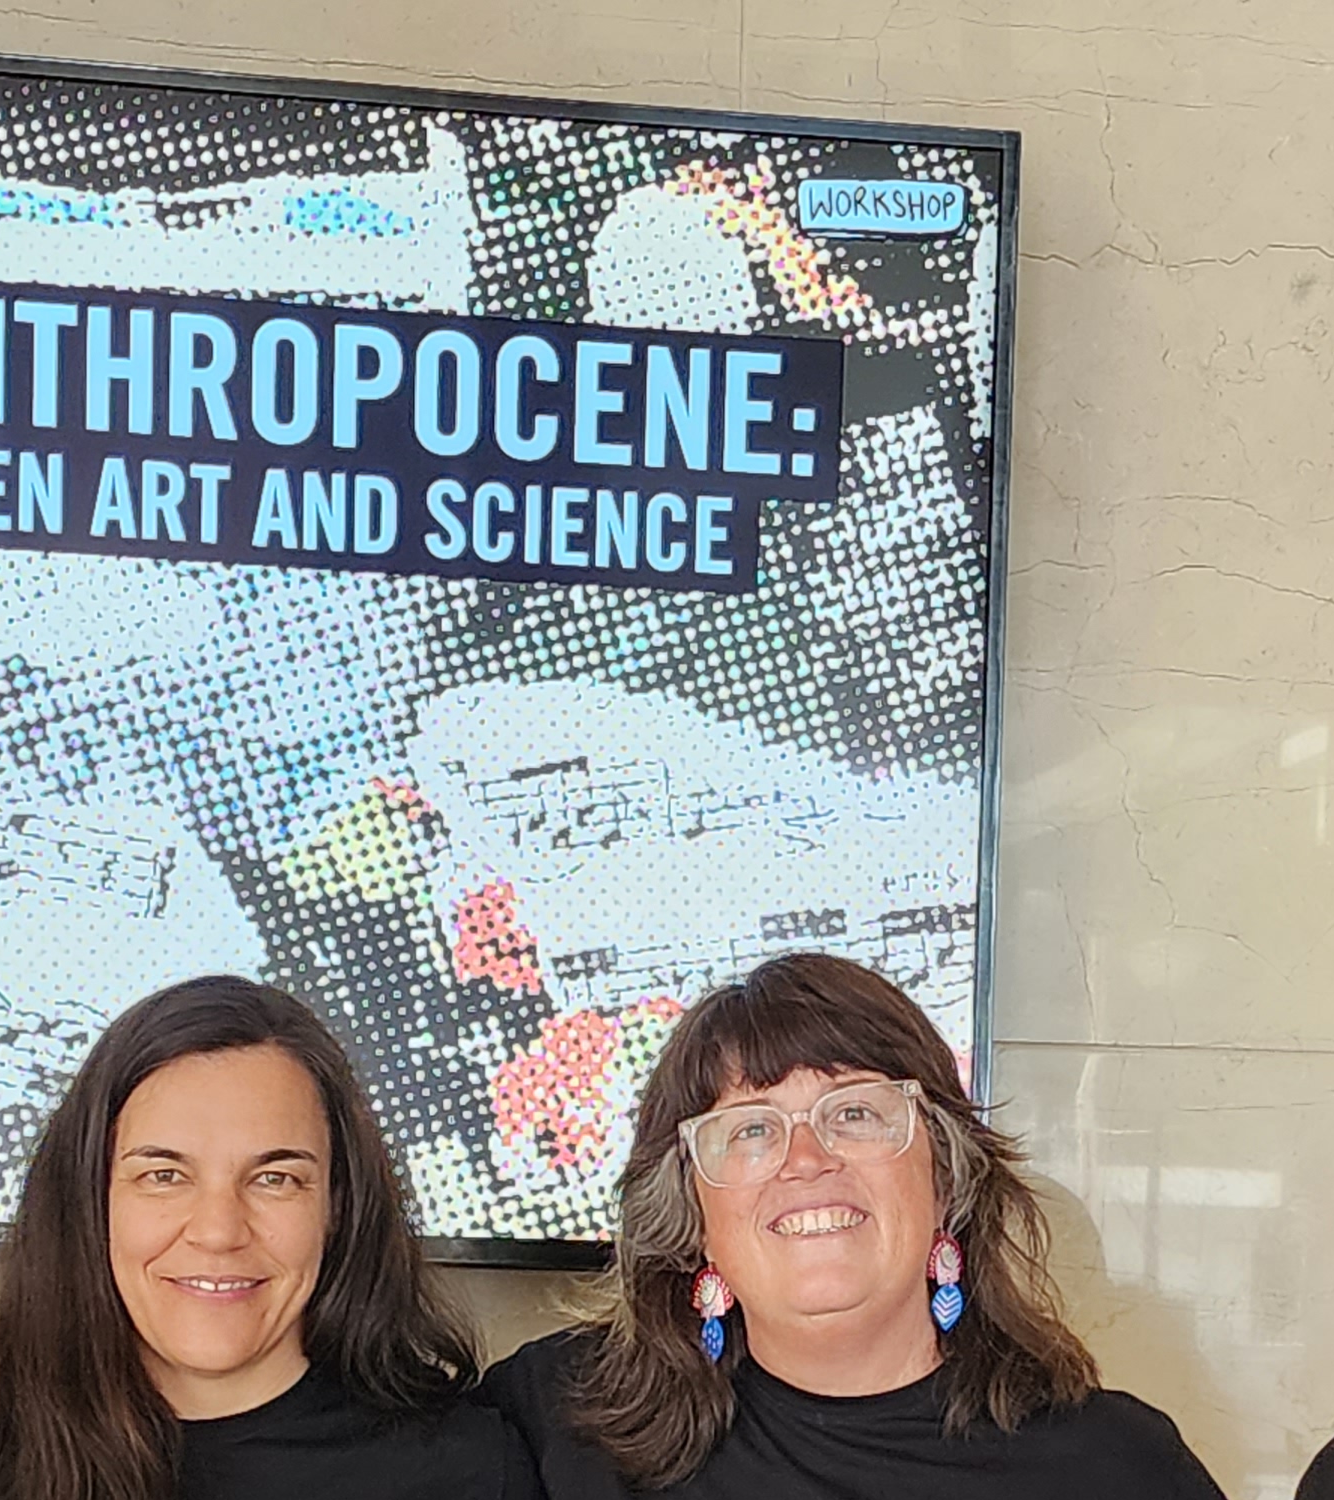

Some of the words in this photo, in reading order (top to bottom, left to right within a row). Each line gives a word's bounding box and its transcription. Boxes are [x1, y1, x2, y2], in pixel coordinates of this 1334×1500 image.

[809, 186, 956, 222] WORKSHOP
[90, 456, 230, 544] ART
[252, 467, 398, 556] AND
[424, 477, 733, 575] SCIENCE
